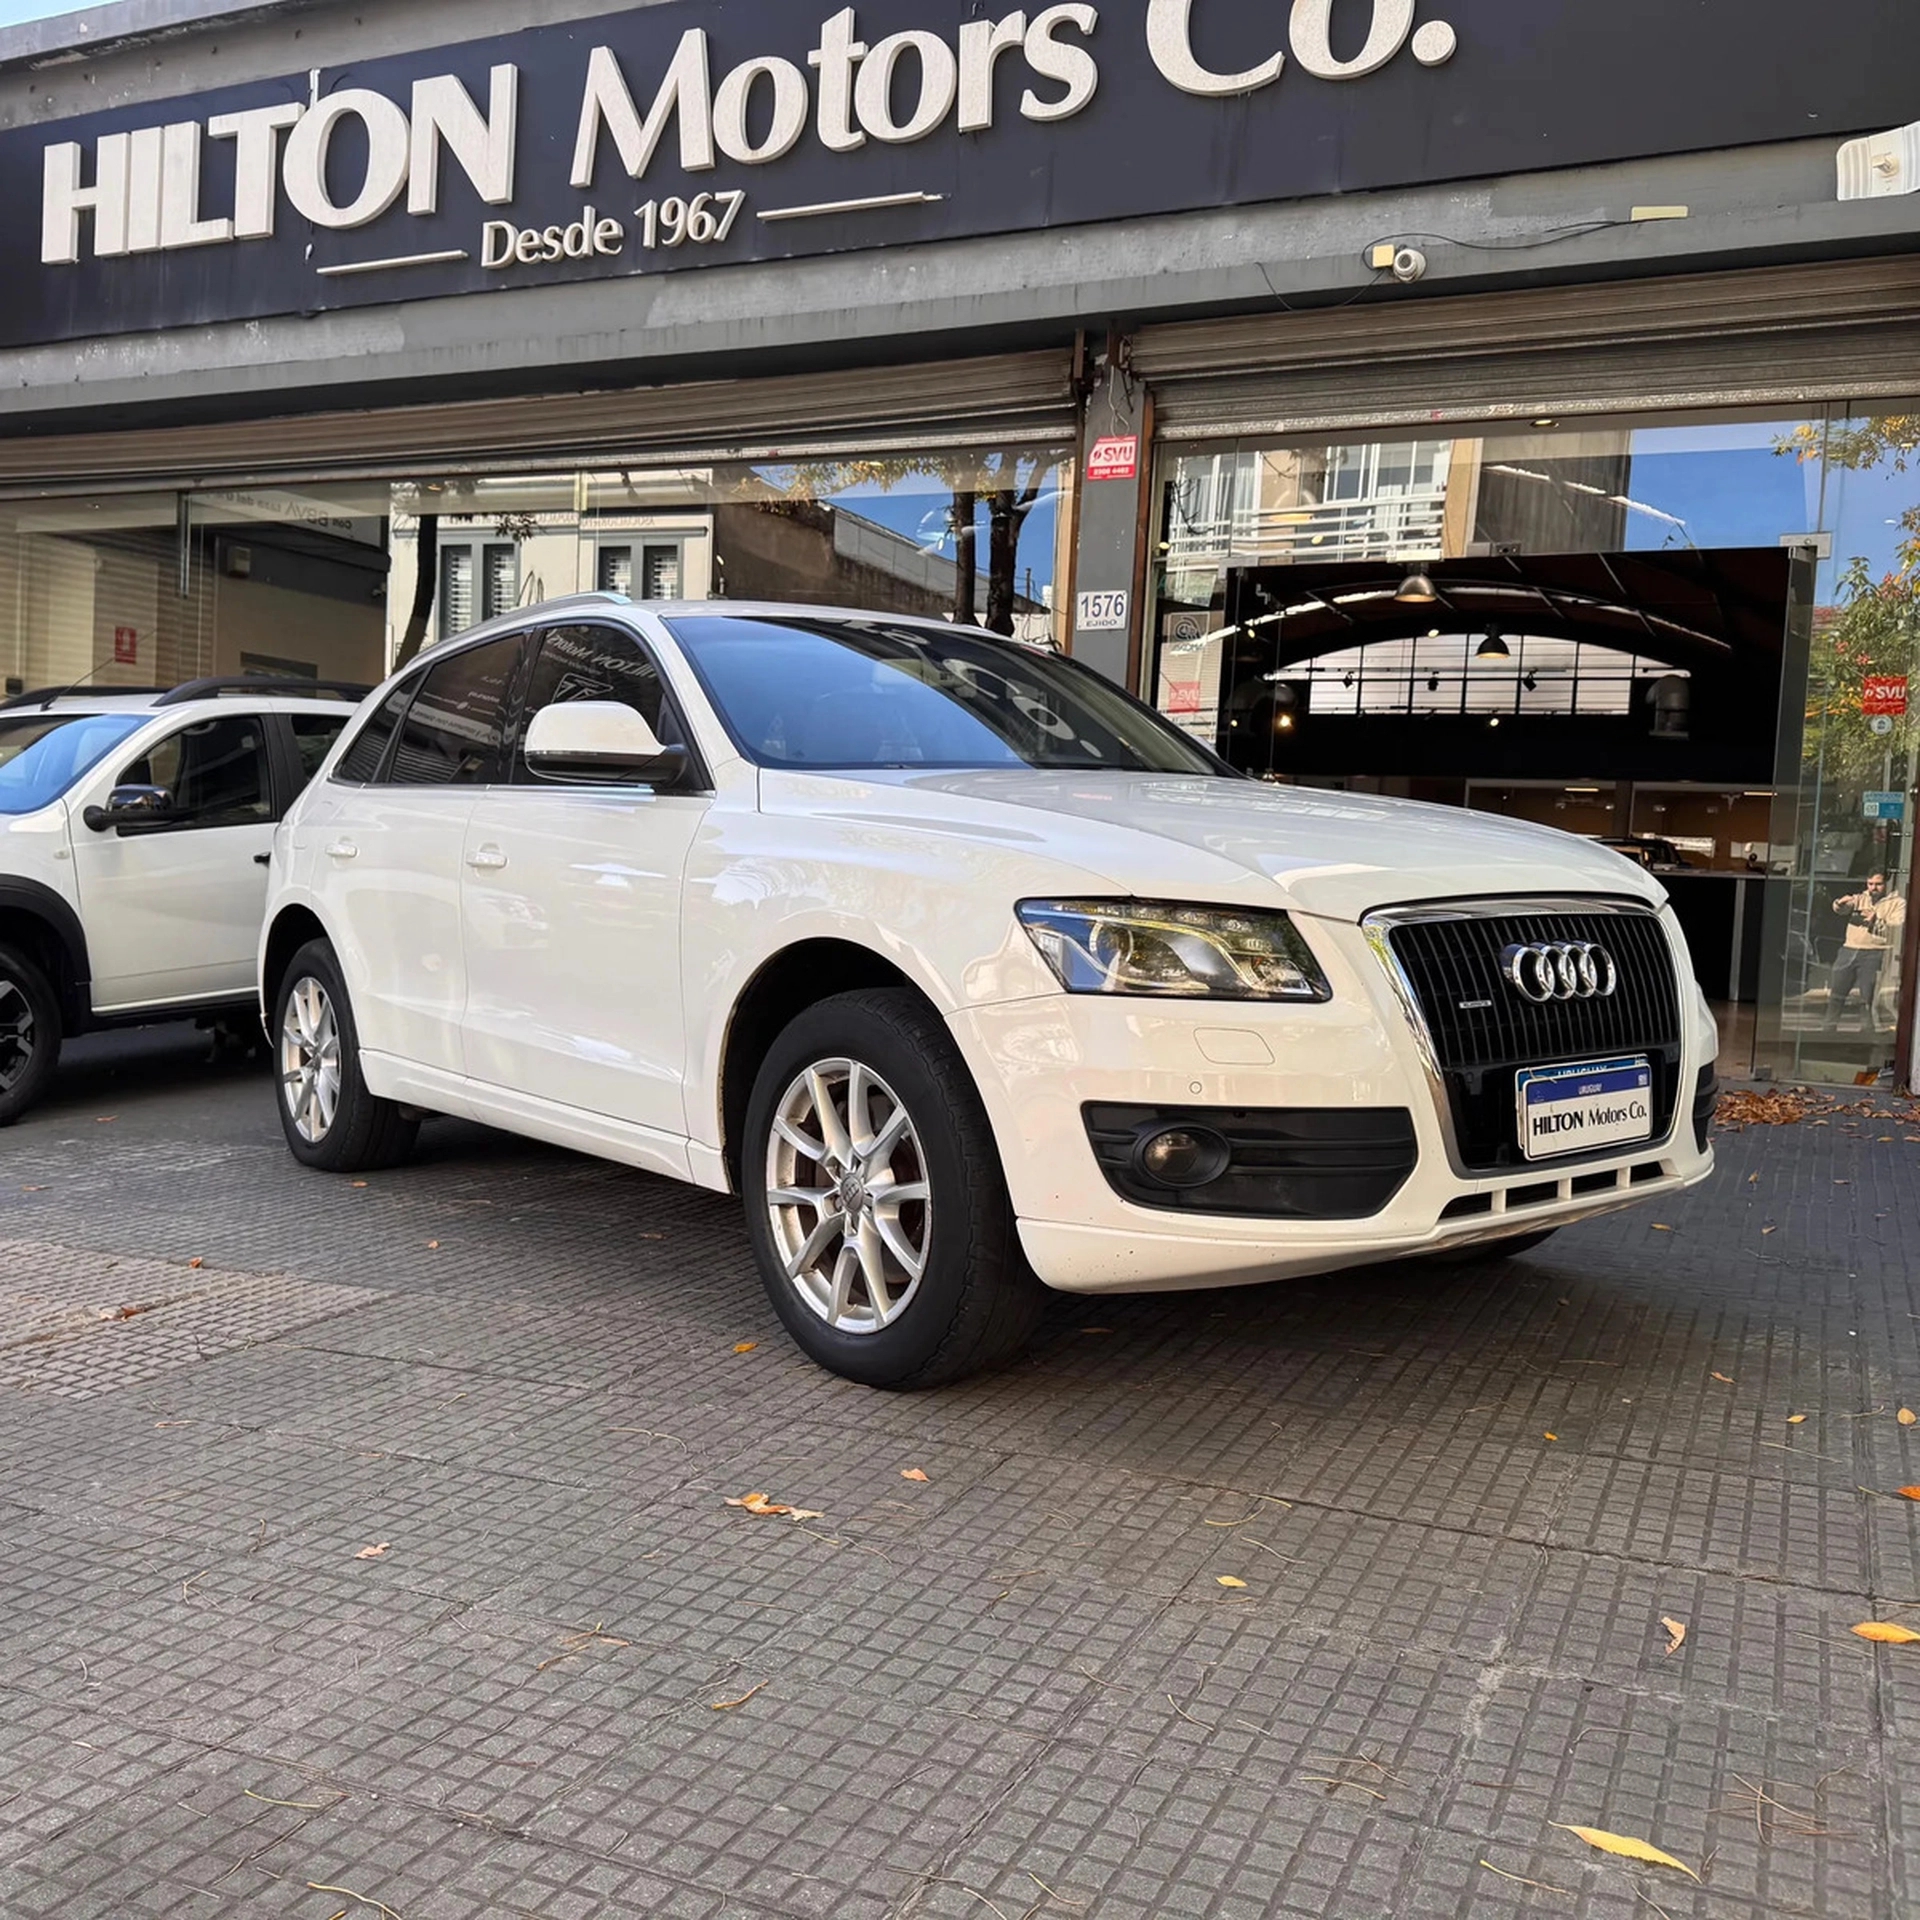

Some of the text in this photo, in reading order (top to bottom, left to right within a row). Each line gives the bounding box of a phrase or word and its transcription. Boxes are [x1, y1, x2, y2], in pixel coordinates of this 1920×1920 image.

[41, 0, 1457, 264] HILTON Motors Co.
[481, 190, 746, 269] Desde 1967
[1103, 446, 1133, 462] SVU
[1081, 594, 1125, 618] 1576
[1086, 619, 1117, 627] EJIDO
[1875, 686, 1906, 700] SVU
[1533, 1101, 1647, 1136] HILTON Motors Co.
